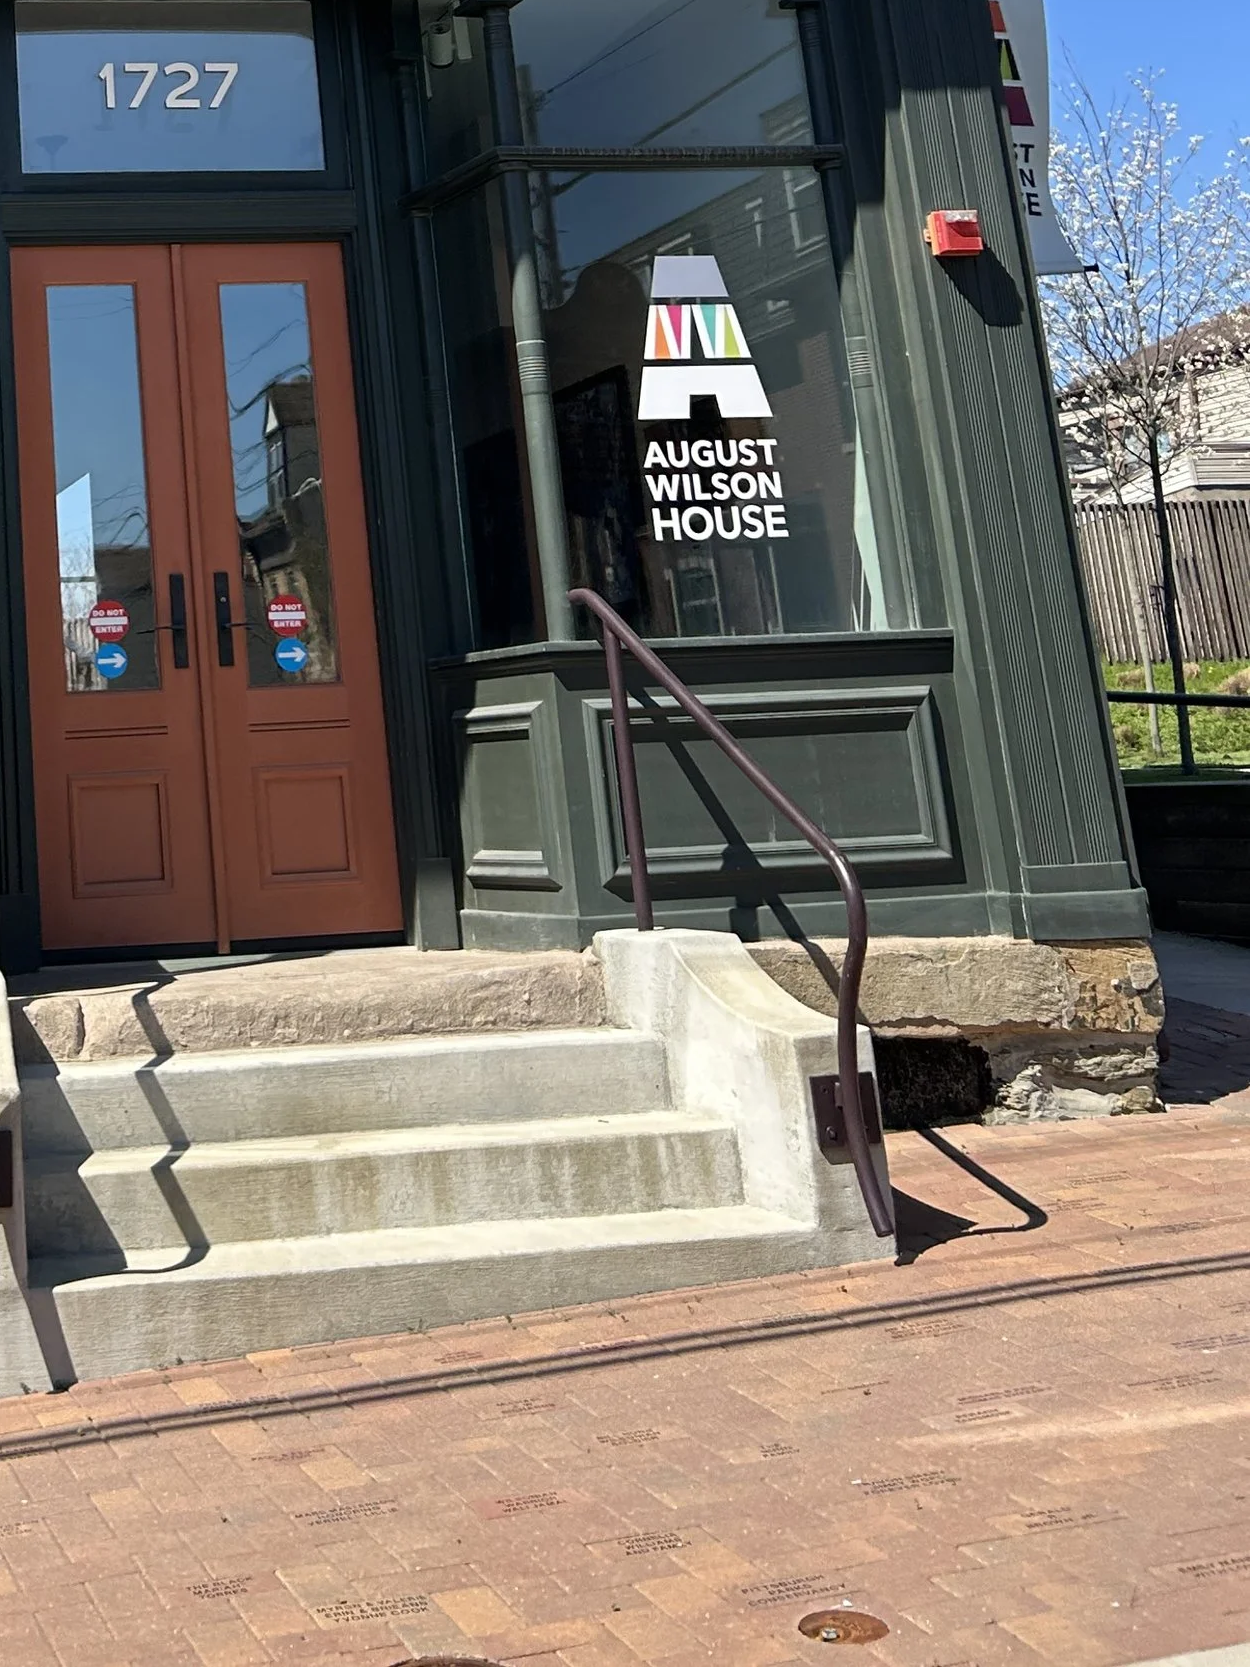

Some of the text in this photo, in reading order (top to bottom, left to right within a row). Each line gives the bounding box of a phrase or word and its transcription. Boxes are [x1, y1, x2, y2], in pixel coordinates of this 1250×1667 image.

[98, 62, 239, 109] 1727
[643, 438, 777, 469] AUGUST
[645, 471, 784, 503] WILSON
[651, 504, 790, 542] HOUSE
[741, 1574, 825, 1595] PITTSBURGH
[748, 1583, 846, 1607] CONSERVANCY
[767, 1583, 812, 1595] PARKS
[390, 1606, 430, 1616] COOK
